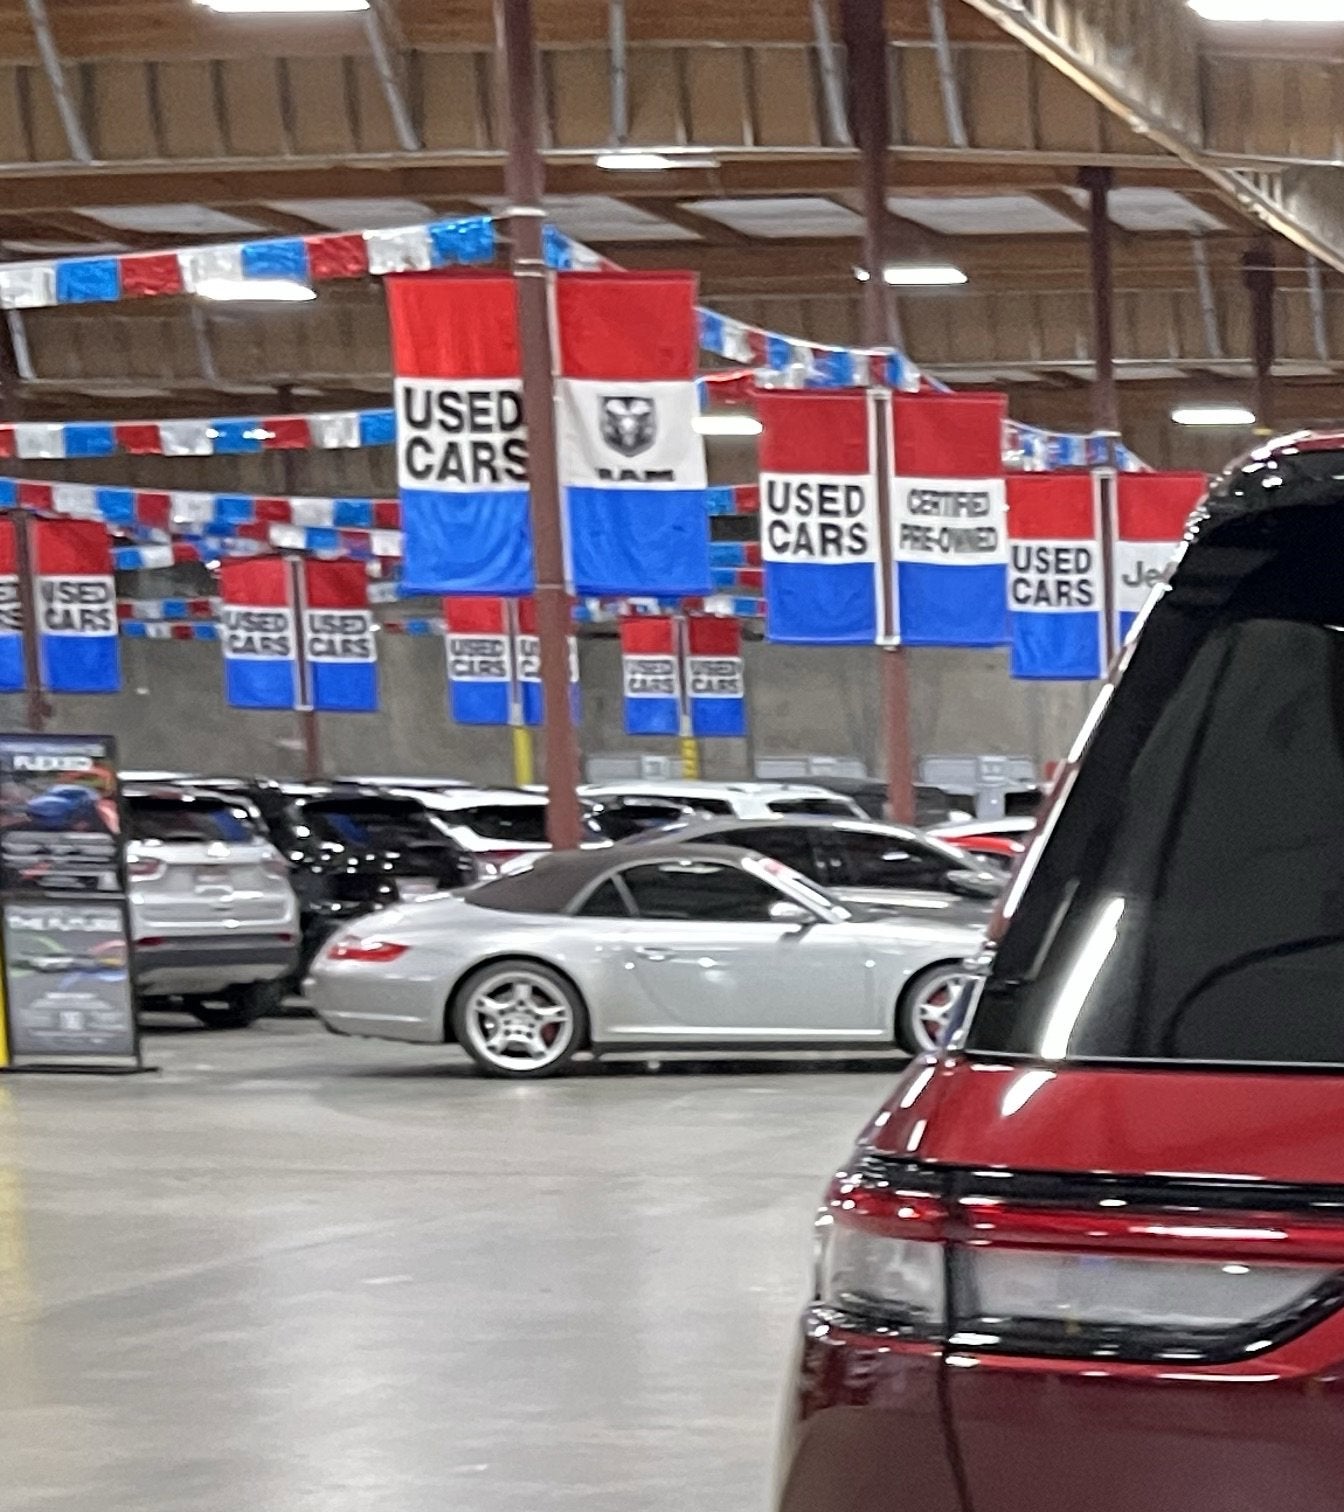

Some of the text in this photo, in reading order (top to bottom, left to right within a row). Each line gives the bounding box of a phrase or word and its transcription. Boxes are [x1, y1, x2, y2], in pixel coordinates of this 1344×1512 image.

[403, 387, 522, 433] USED
[405, 436, 528, 483] CARS
[767, 481, 865, 518] USED
[907, 488, 990, 518] CERTIFIED
[767, 521, 868, 555] CARS
[899, 523, 997, 553] PRE-OWNED
[1012, 546, 1092, 575] USED
[1121, 561, 1163, 588] Je
[42, 582, 109, 604] USED
[1012, 577, 1094, 606] CARS
[45, 608, 111, 631] CARS
[222, 611, 289, 633] USED
[308, 613, 368, 635] USED
[229, 634, 290, 656] CARS
[309, 637, 371, 658] CARS
[451, 638, 507, 656] USED
[451, 659, 508, 678] CARS
[629, 677, 674, 693] CARS
[692, 678, 738, 694] CARS
